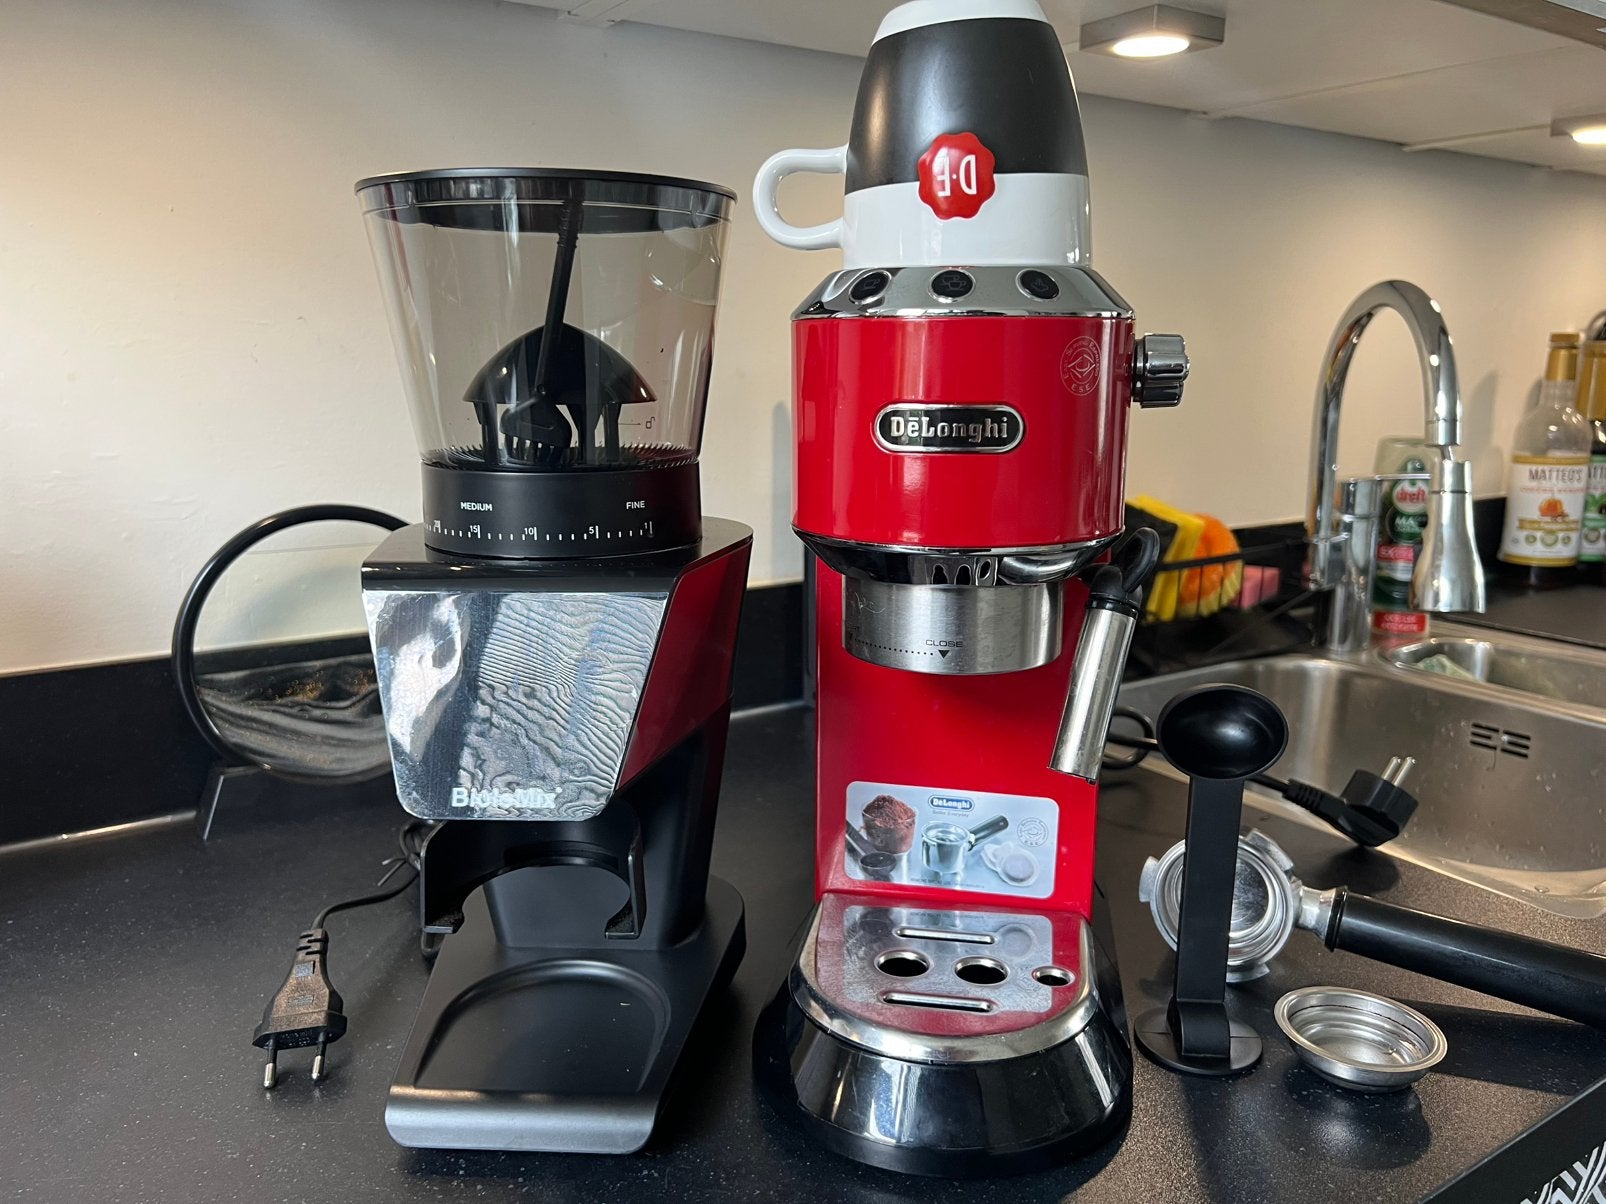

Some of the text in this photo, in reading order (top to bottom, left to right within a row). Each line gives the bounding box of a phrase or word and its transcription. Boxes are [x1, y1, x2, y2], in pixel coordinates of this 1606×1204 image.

[460, 500, 646, 512] MEDIUM FINE
[469, 525, 478, 534] 15
[523, 527, 534, 535] 10
[588, 526, 595, 535] 5
[925, 639, 963, 648] CLOSE
